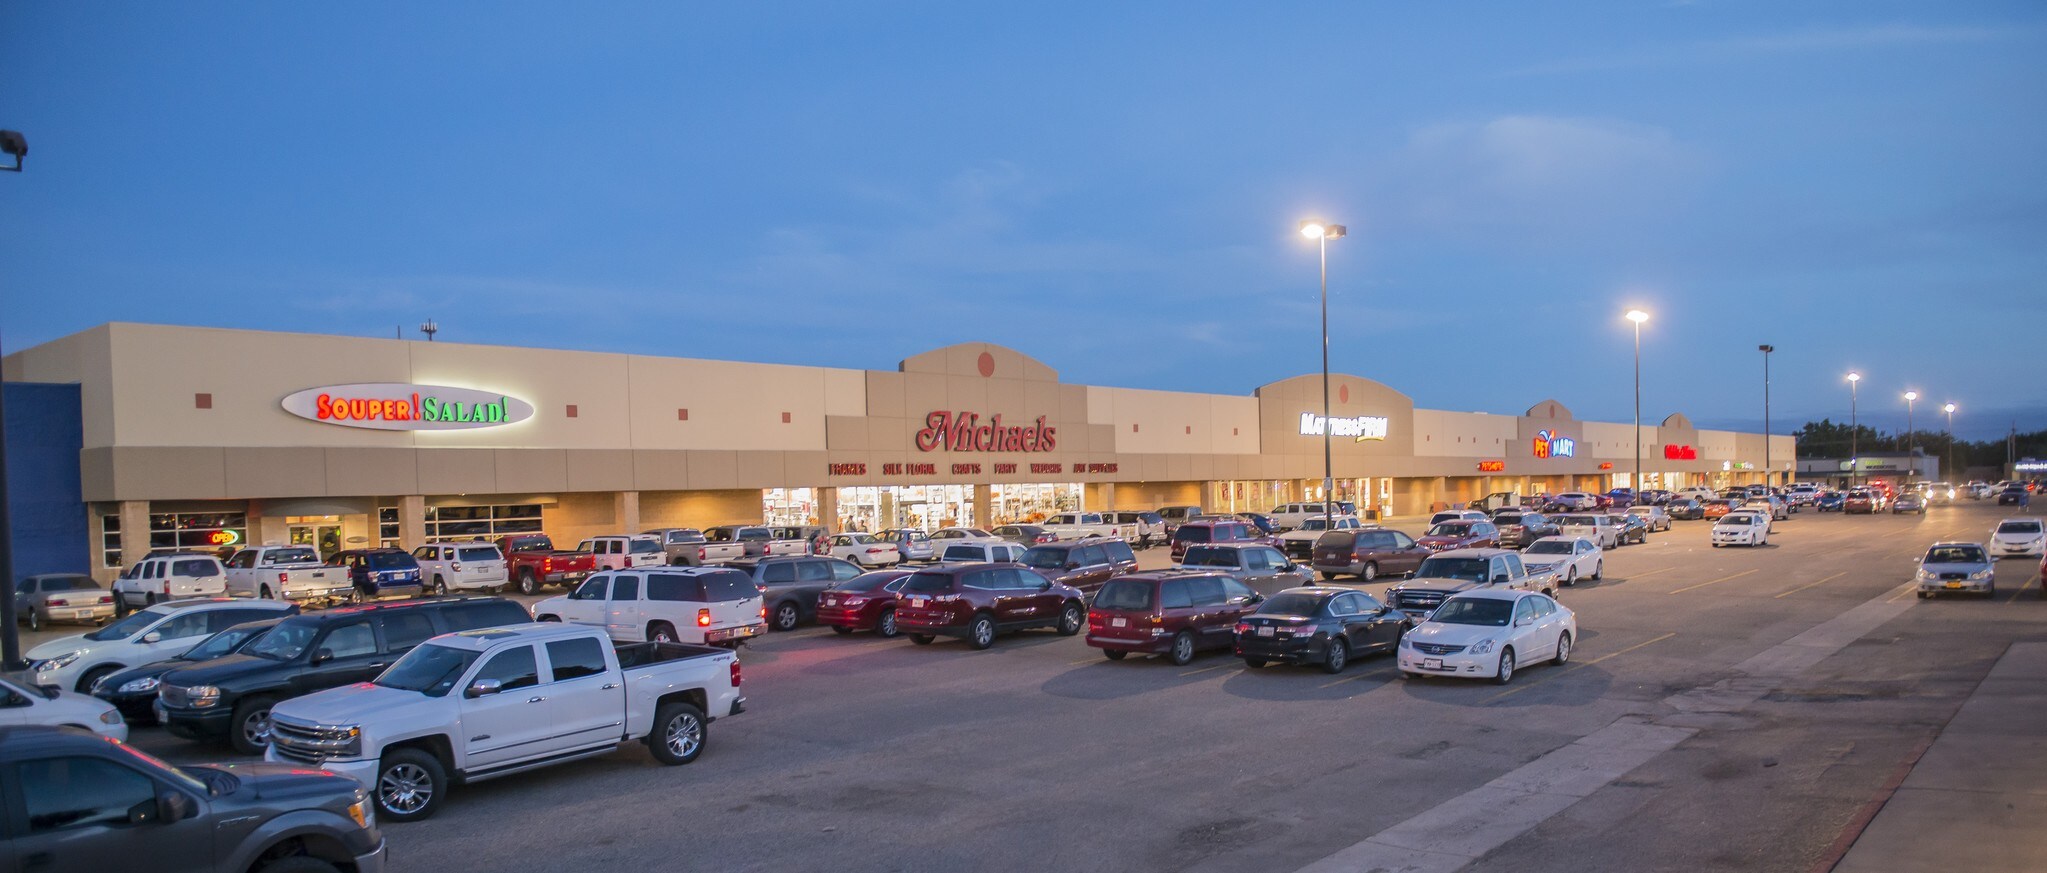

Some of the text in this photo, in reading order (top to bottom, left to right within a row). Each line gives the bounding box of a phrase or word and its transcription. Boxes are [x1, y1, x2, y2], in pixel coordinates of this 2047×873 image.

[316, 393, 510, 422] SOUPER! SALAD!
[915, 410, 1056, 452] Michaels
[994, 463, 1017, 474] PARTY
[211, 533, 235, 543] OPEN
